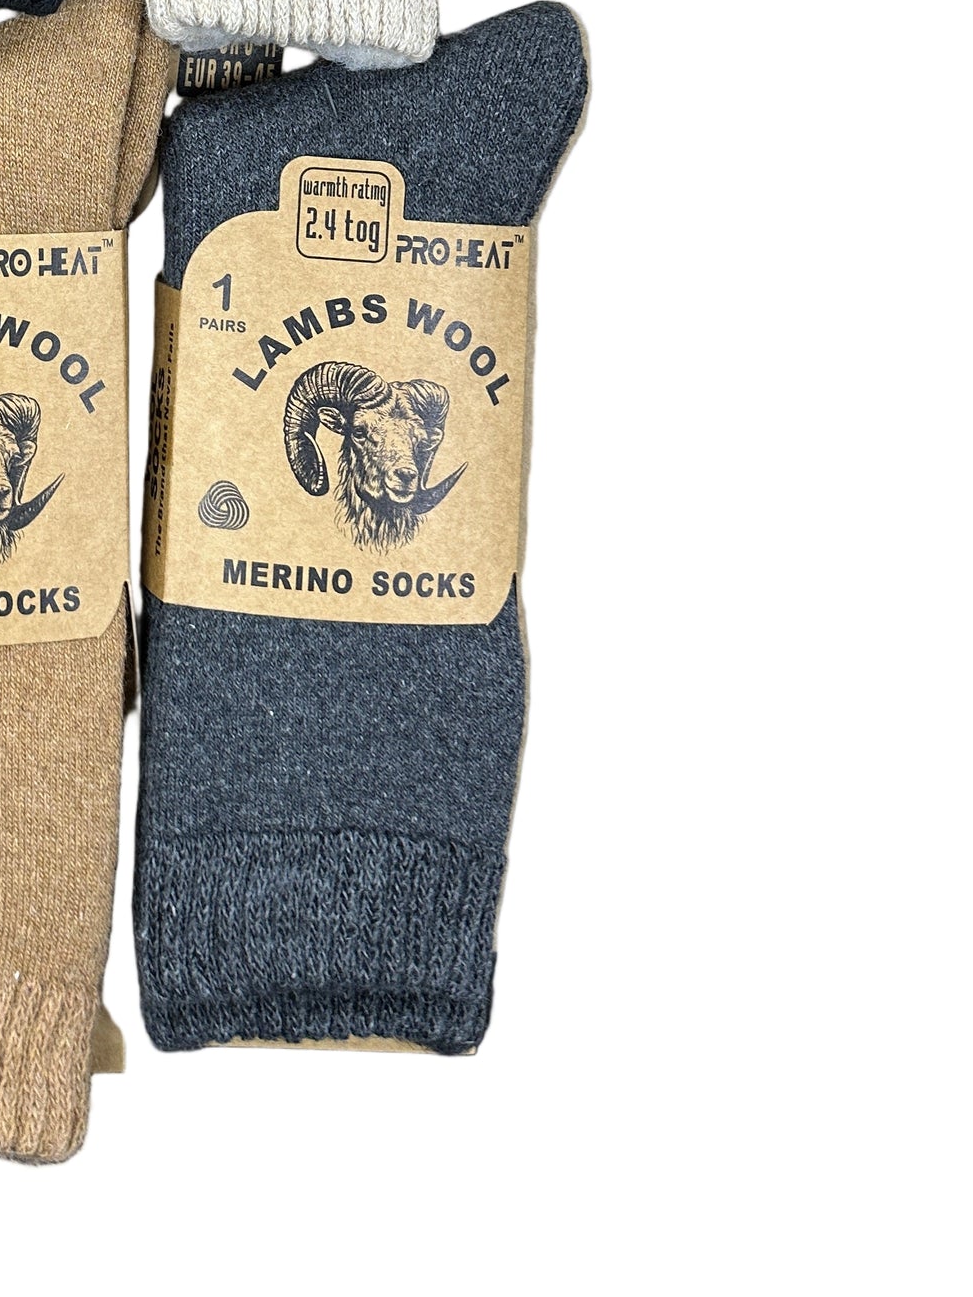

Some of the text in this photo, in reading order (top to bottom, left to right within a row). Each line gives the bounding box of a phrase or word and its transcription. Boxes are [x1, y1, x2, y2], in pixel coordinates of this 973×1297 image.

[184, 57, 217, 89] EUR
[303, 175, 387, 208] warmth rating
[305, 206, 380, 253] 2.4 tog
[212, 273, 232, 312] 1
[199, 317, 246, 333] PAIRS
[232, 293, 510, 407] LAMBS WOOL
[150, 368, 164, 501] SOCKS
[223, 558, 475, 598] MERINO SOCKS
